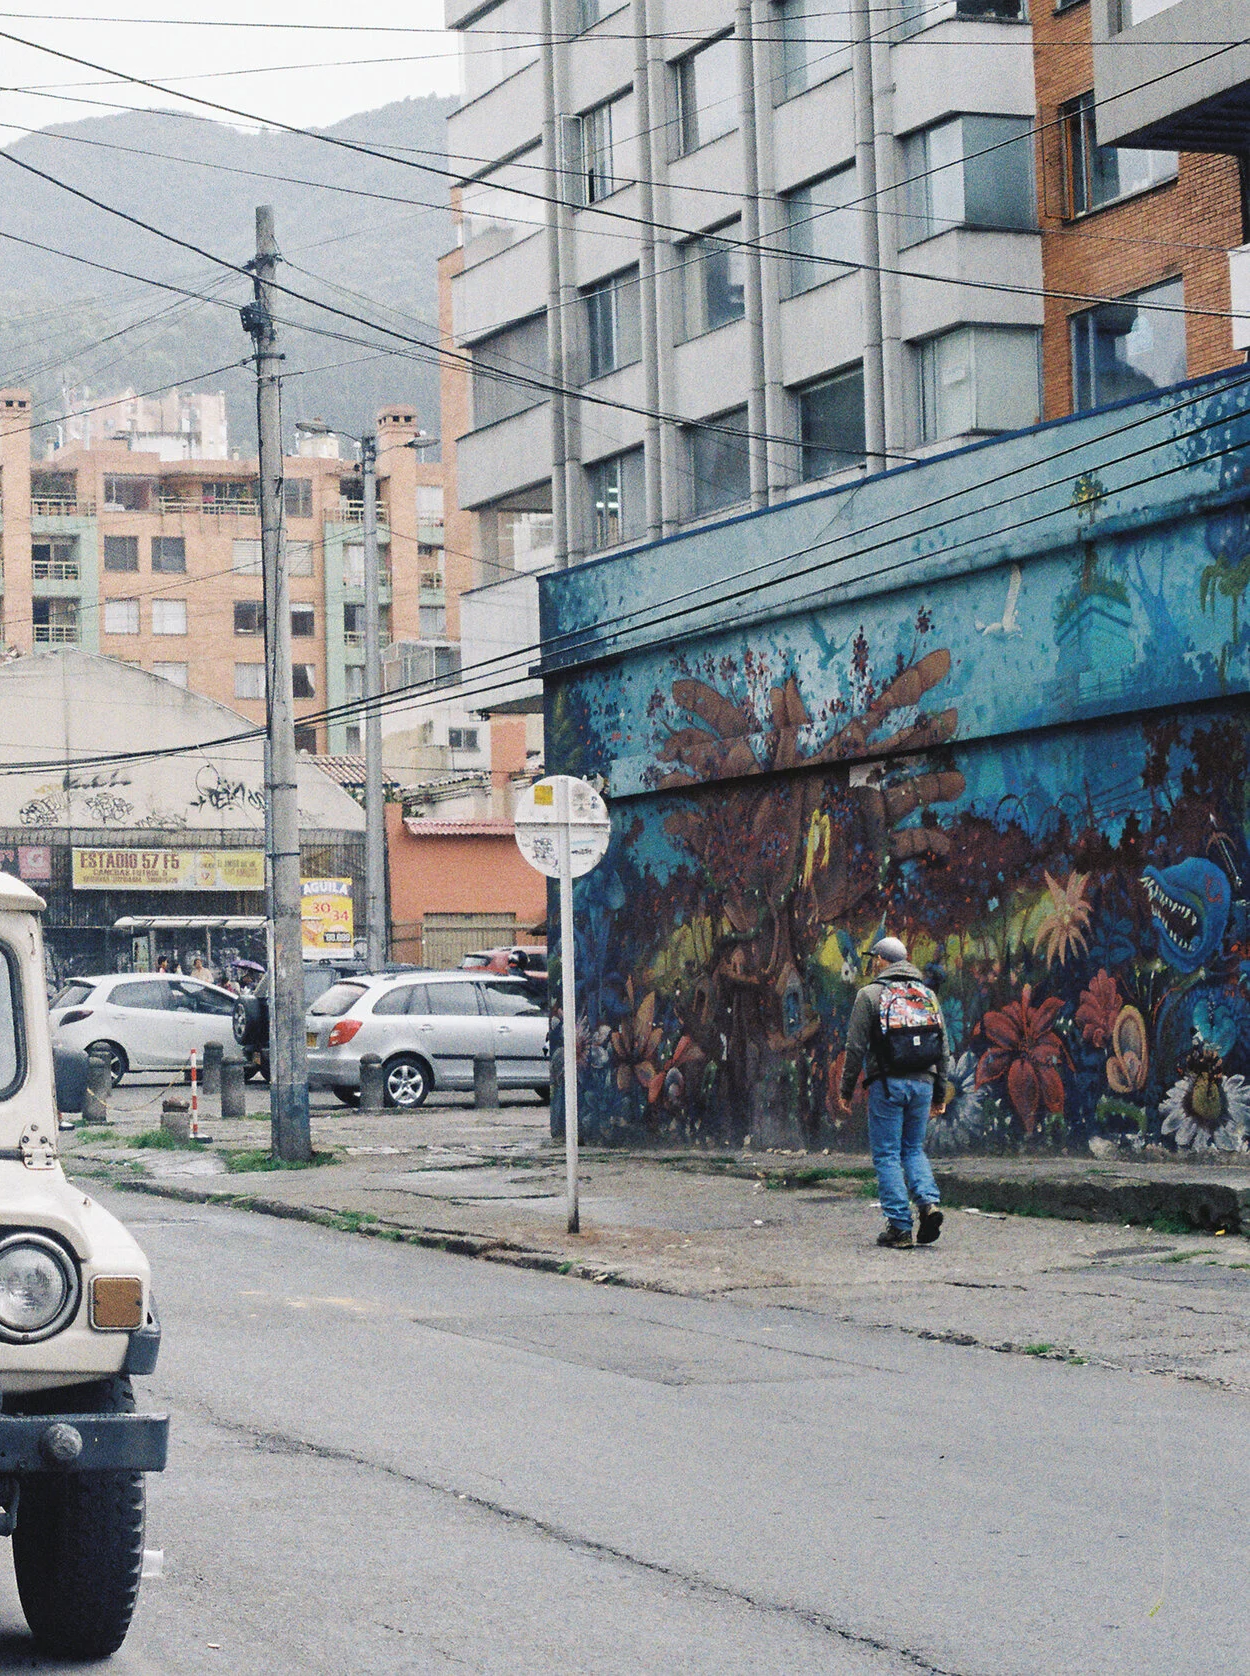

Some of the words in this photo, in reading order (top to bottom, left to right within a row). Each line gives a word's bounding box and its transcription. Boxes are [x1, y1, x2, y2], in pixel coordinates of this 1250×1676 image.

[80, 853, 138, 869] ESTADIO
[141, 853, 160, 869] 57
[163, 853, 180, 870] F5
[312, 902, 331, 914] 30
[332, 910, 349, 921] 34
